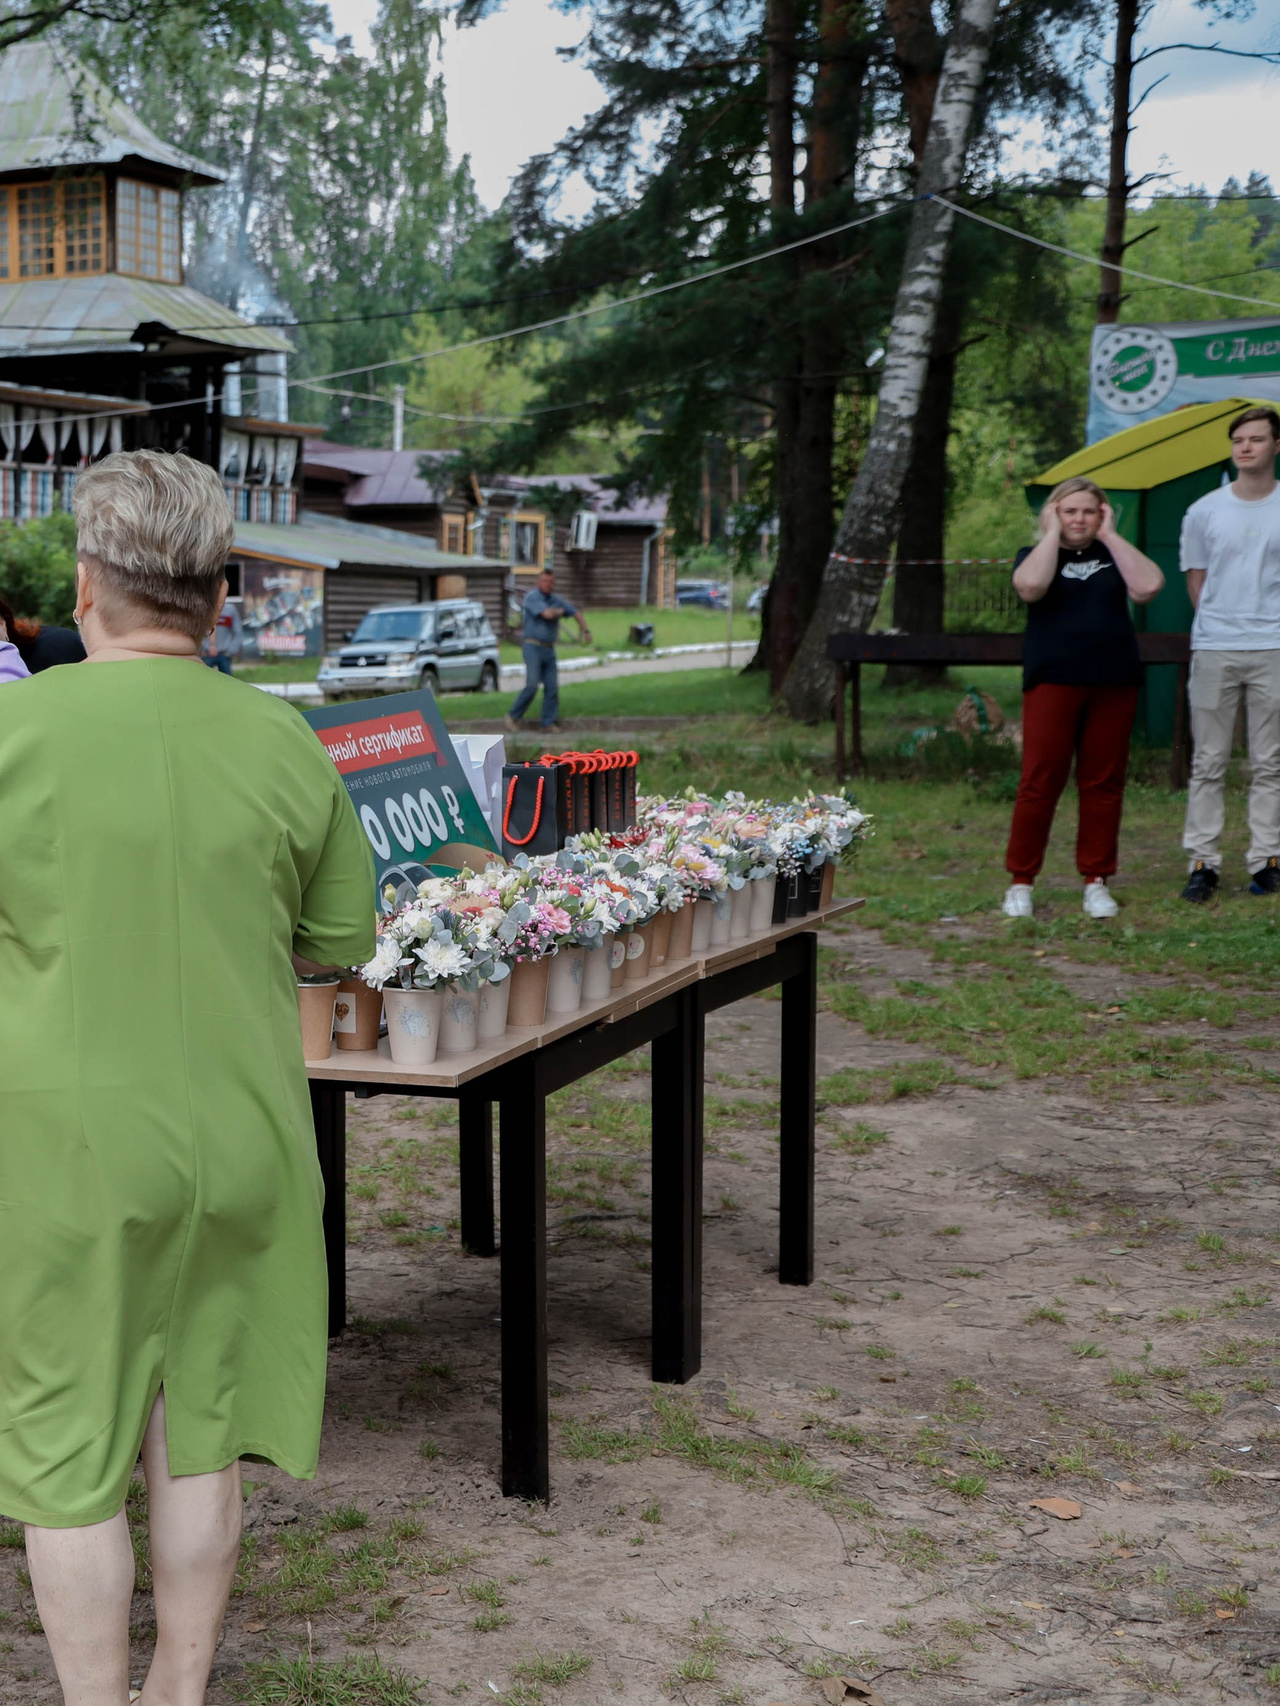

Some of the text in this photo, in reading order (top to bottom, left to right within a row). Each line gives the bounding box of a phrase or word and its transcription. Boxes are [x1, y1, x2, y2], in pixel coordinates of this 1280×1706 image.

[359, 724, 425, 759] сертификат
[365, 773, 391, 786] НОВОГО
[392, 761, 432, 778] АВТОМОБИЛЯ
[360, 804, 391, 861] 0
[384, 788, 449, 853] 000
